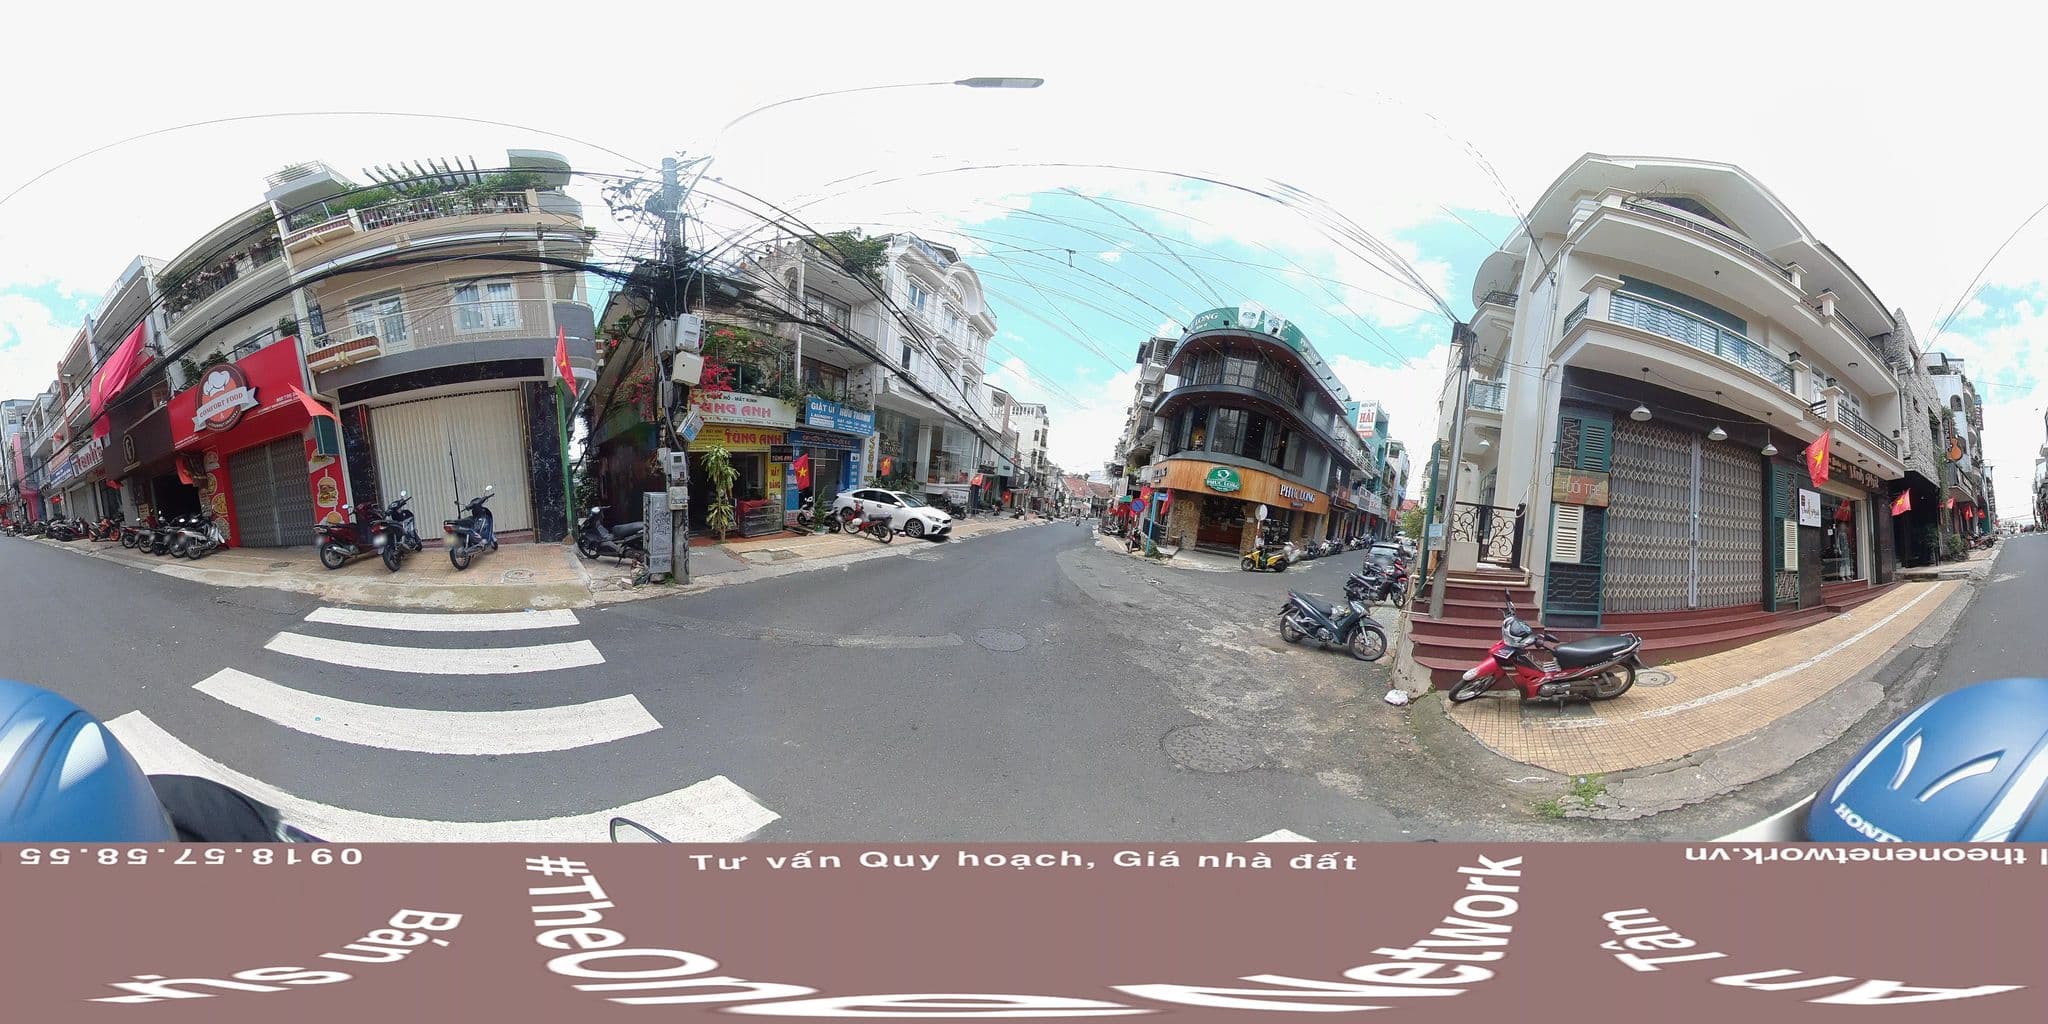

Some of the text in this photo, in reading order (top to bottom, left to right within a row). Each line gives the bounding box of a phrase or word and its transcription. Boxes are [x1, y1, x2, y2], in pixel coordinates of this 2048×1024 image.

[199, 391, 244, 418] COMFORT FOOD
[741, 404, 771, 418] ANH
[725, 429, 756, 446] TÙNG
[759, 432, 784, 446] ANH
[1299, 489, 1315, 502] LONG
